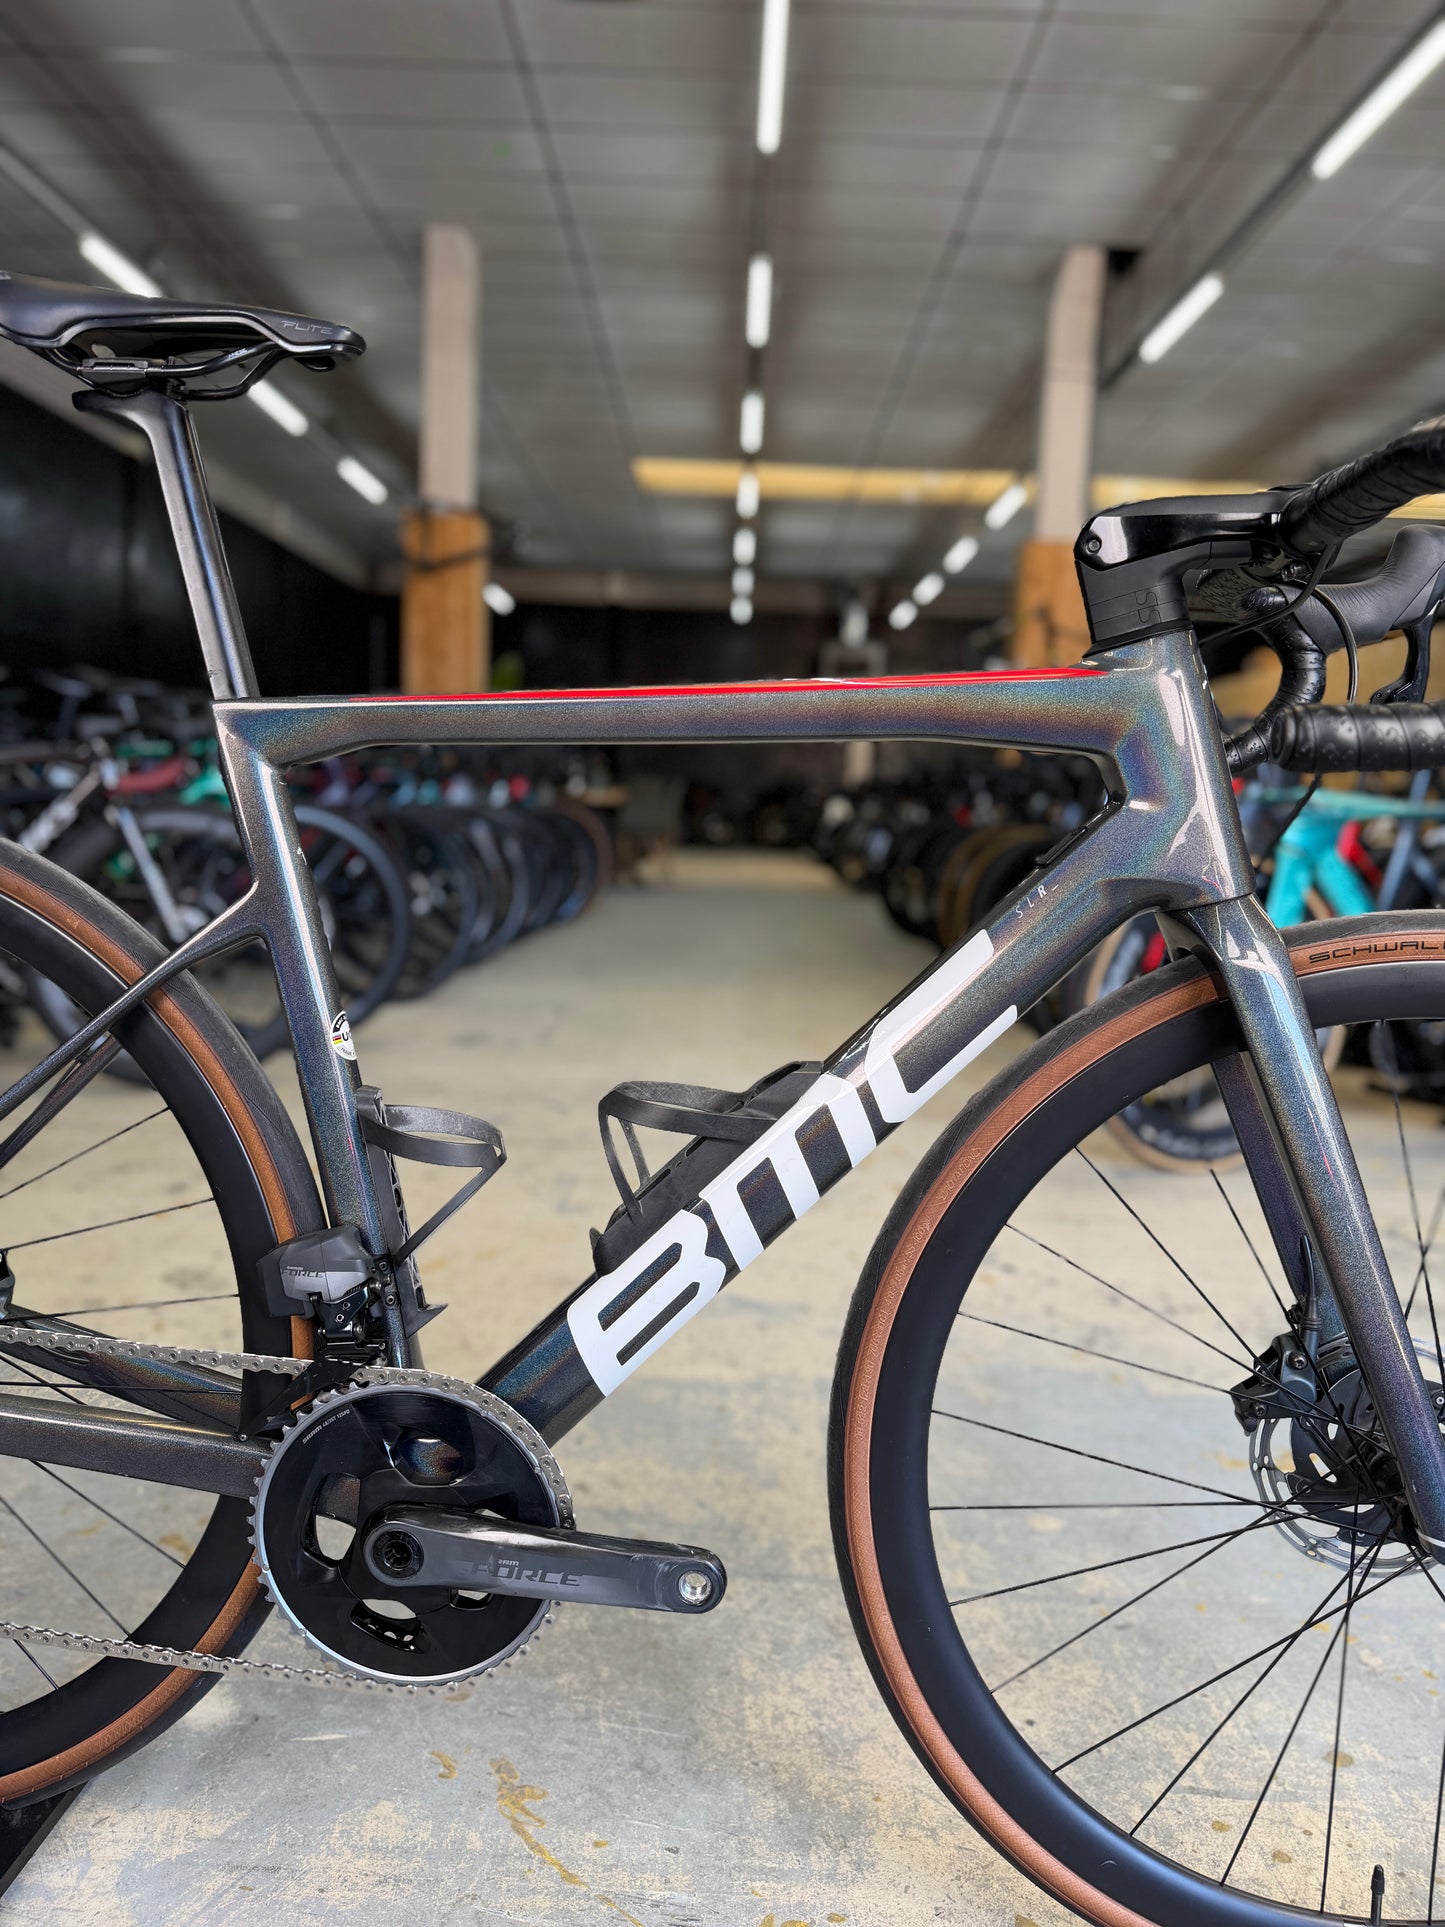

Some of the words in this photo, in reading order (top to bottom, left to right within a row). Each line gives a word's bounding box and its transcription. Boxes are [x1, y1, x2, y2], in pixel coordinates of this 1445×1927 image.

[281, 320, 333, 335] FLITE
[1308, 940, 1445, 964] SCHWAL
[566, 928, 1018, 1398] BMC
[280, 1269, 324, 1279] FORCE
[472, 1561, 581, 1587] FORCE
